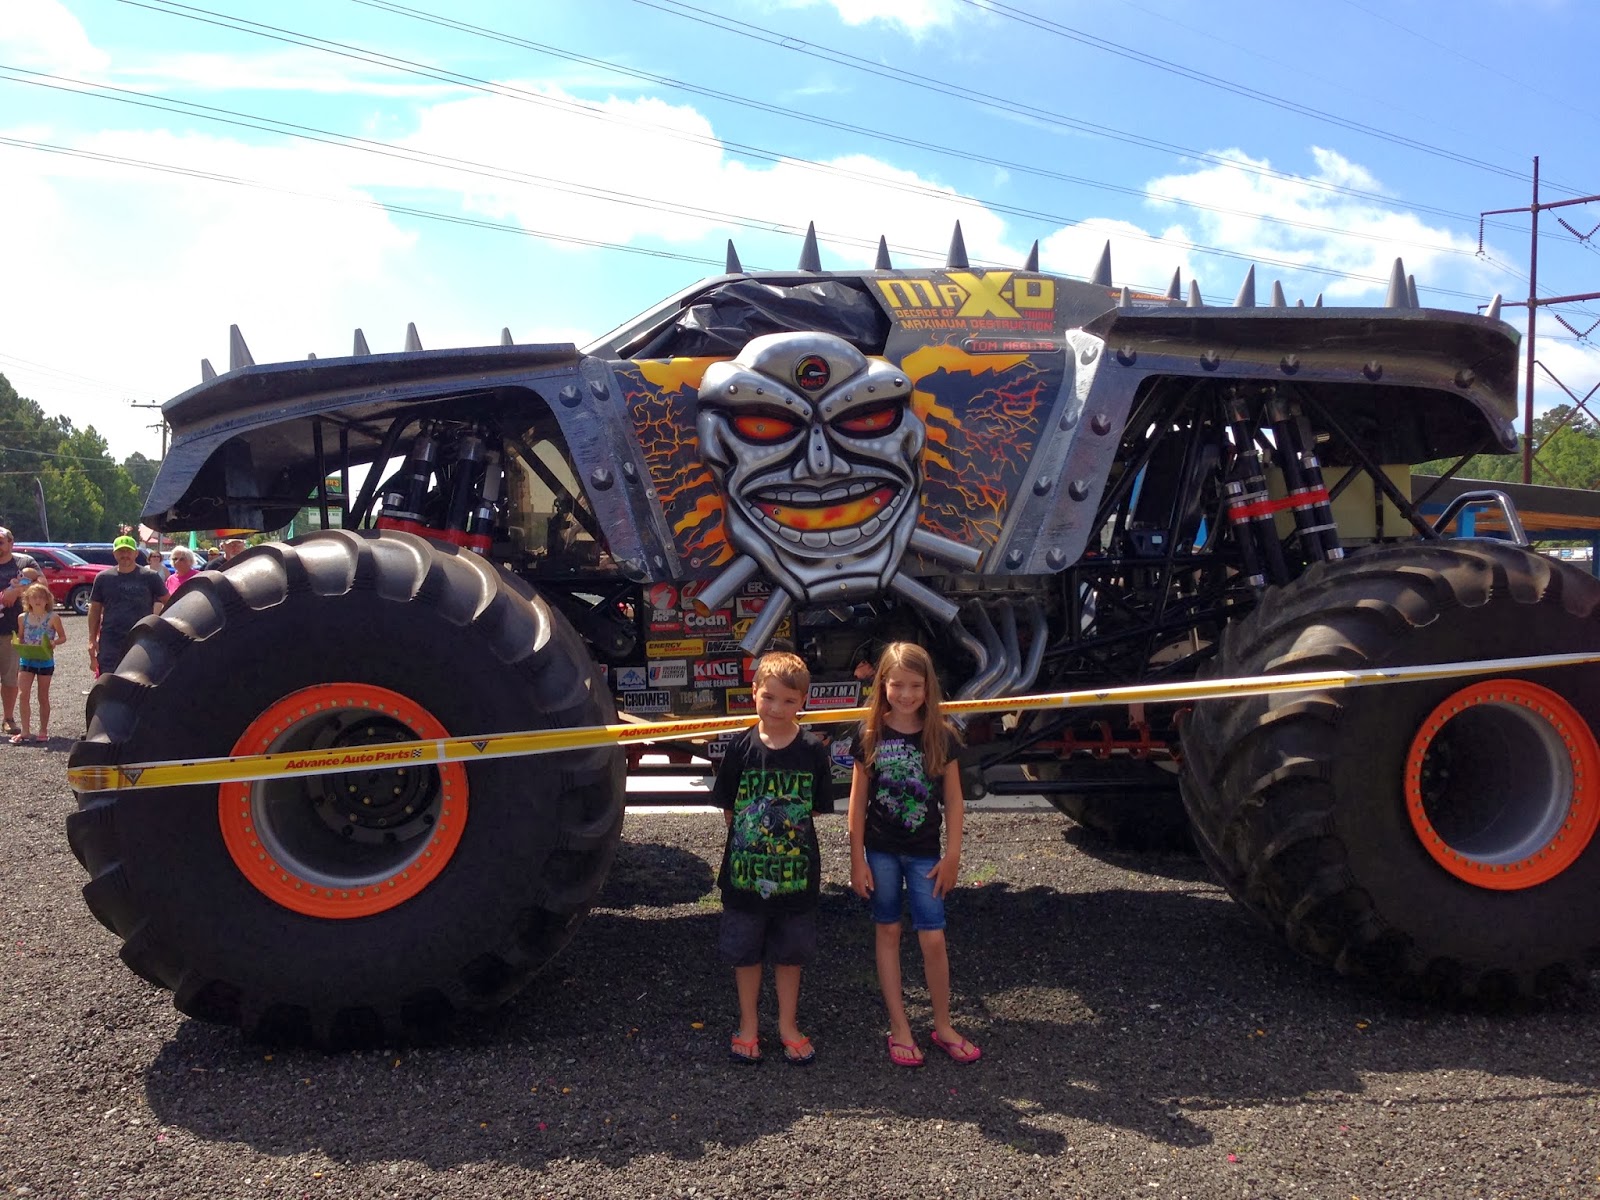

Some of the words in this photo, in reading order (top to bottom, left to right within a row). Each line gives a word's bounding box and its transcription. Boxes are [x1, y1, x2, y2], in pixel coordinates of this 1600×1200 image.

[896, 308, 939, 318] DECADE
[941, 308, 955, 318] OF
[901, 319, 966, 330] MAXIMUM
[970, 319, 1053, 331] DESTRUCTION
[972, 340, 998, 351] TOM
[685, 612, 727, 627] Coan
[649, 642, 681, 650] ENERGY
[694, 662, 738, 676] KING
[694, 680, 712, 688] ENGINE
[812, 686, 855, 698] OPTIMA
[625, 692, 670, 706] CROWER
[619, 727, 669, 737] Advance
[670, 723, 700, 732] Auto
[701, 720, 733, 729] Parts
[285, 758, 339, 769] Advance
[341, 754, 374, 764] Auto
[375, 749, 410, 761] Parts
